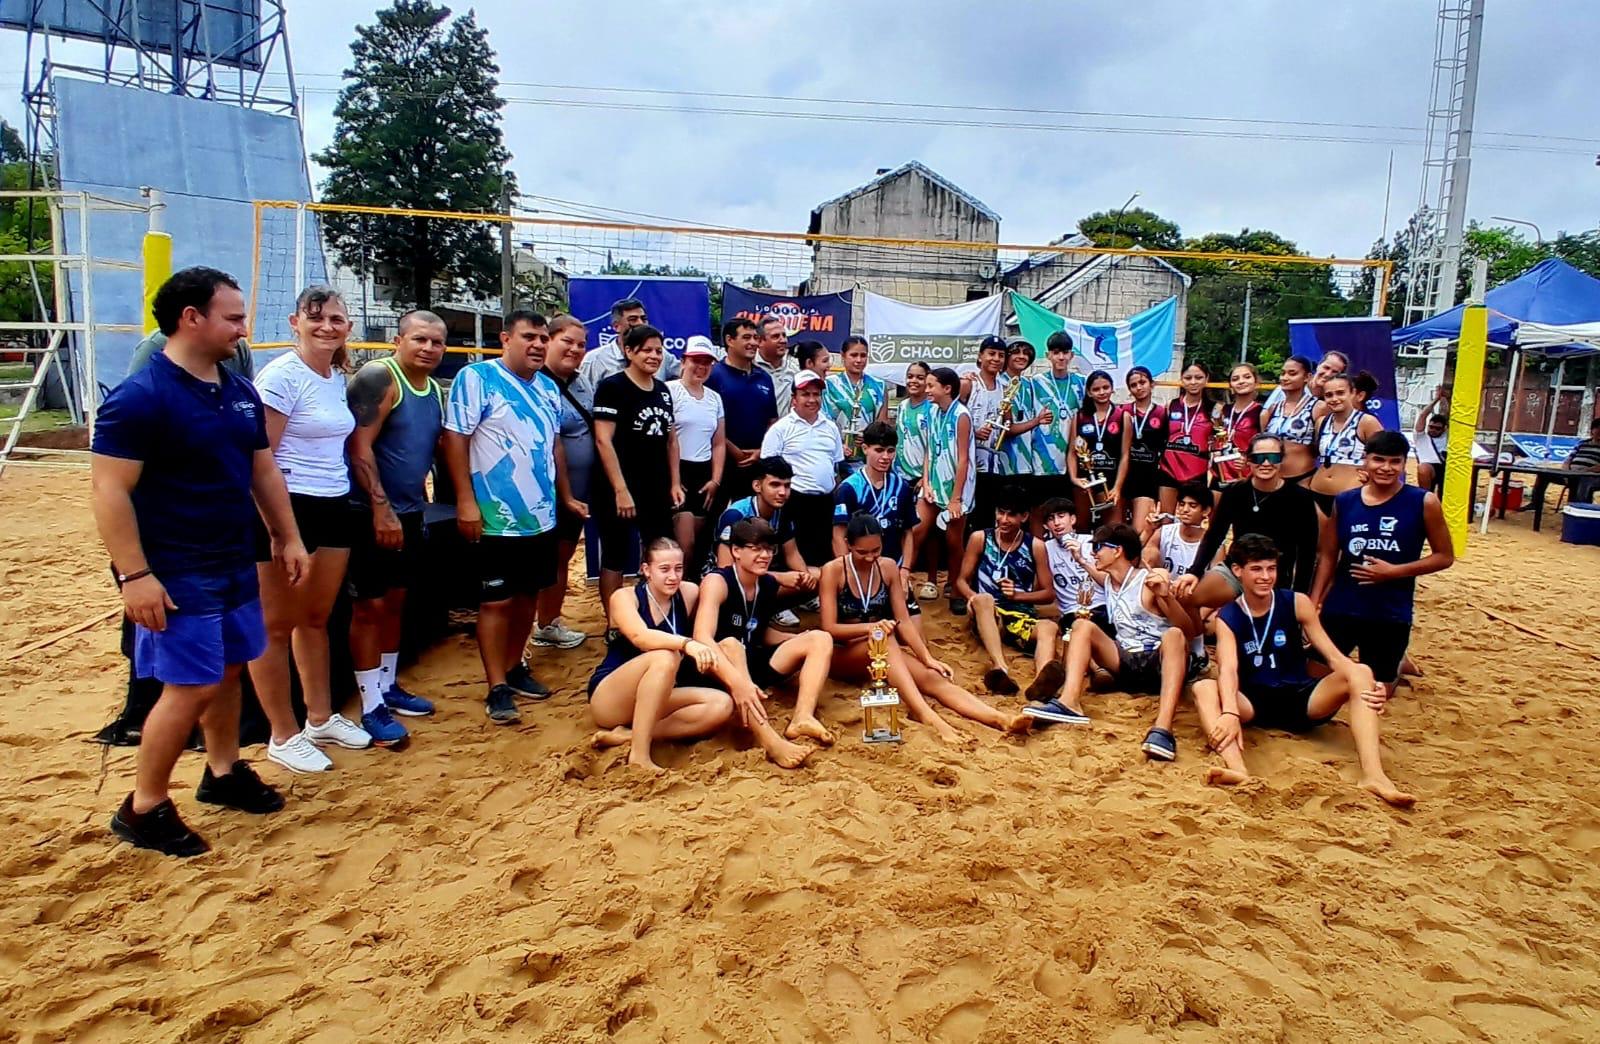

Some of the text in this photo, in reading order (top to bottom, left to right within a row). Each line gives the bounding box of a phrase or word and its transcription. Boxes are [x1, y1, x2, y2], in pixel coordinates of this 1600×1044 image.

[900, 346, 953, 359] CHACO
[1366, 538, 1400, 552] BNA
[1269, 653, 1276, 668] 1
